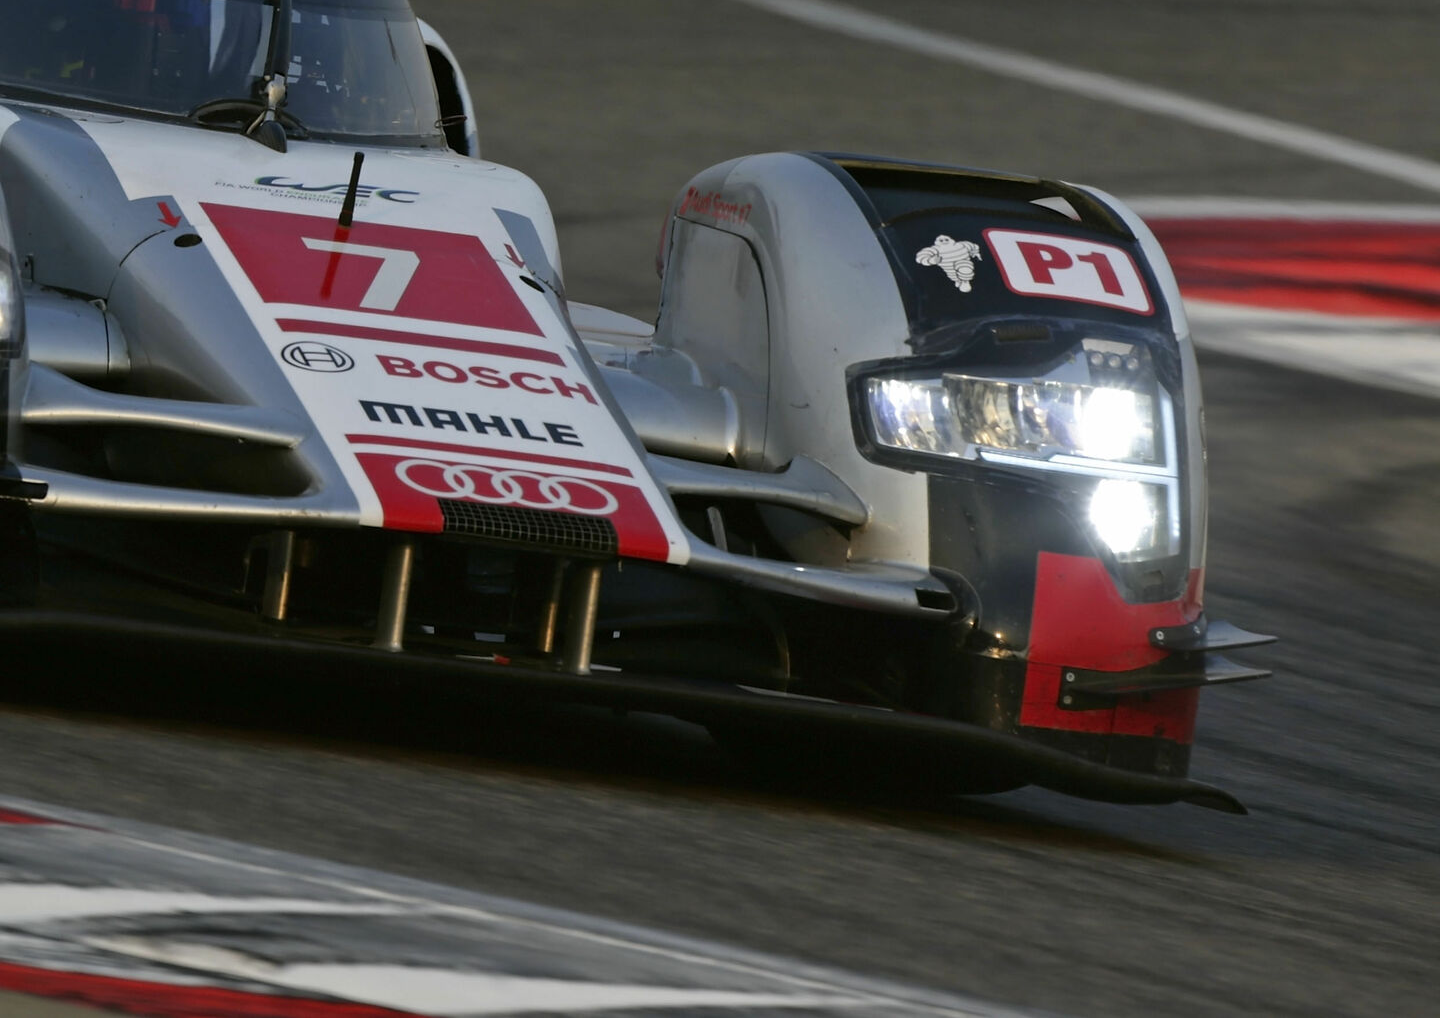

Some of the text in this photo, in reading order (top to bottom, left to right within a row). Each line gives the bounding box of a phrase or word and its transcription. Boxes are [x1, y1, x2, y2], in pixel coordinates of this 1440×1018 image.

[300, 236, 421, 312] 7
[1015, 241, 1125, 297] P1
[374, 354, 599, 406] BOSCH
[358, 400, 585, 448] MAHLE
